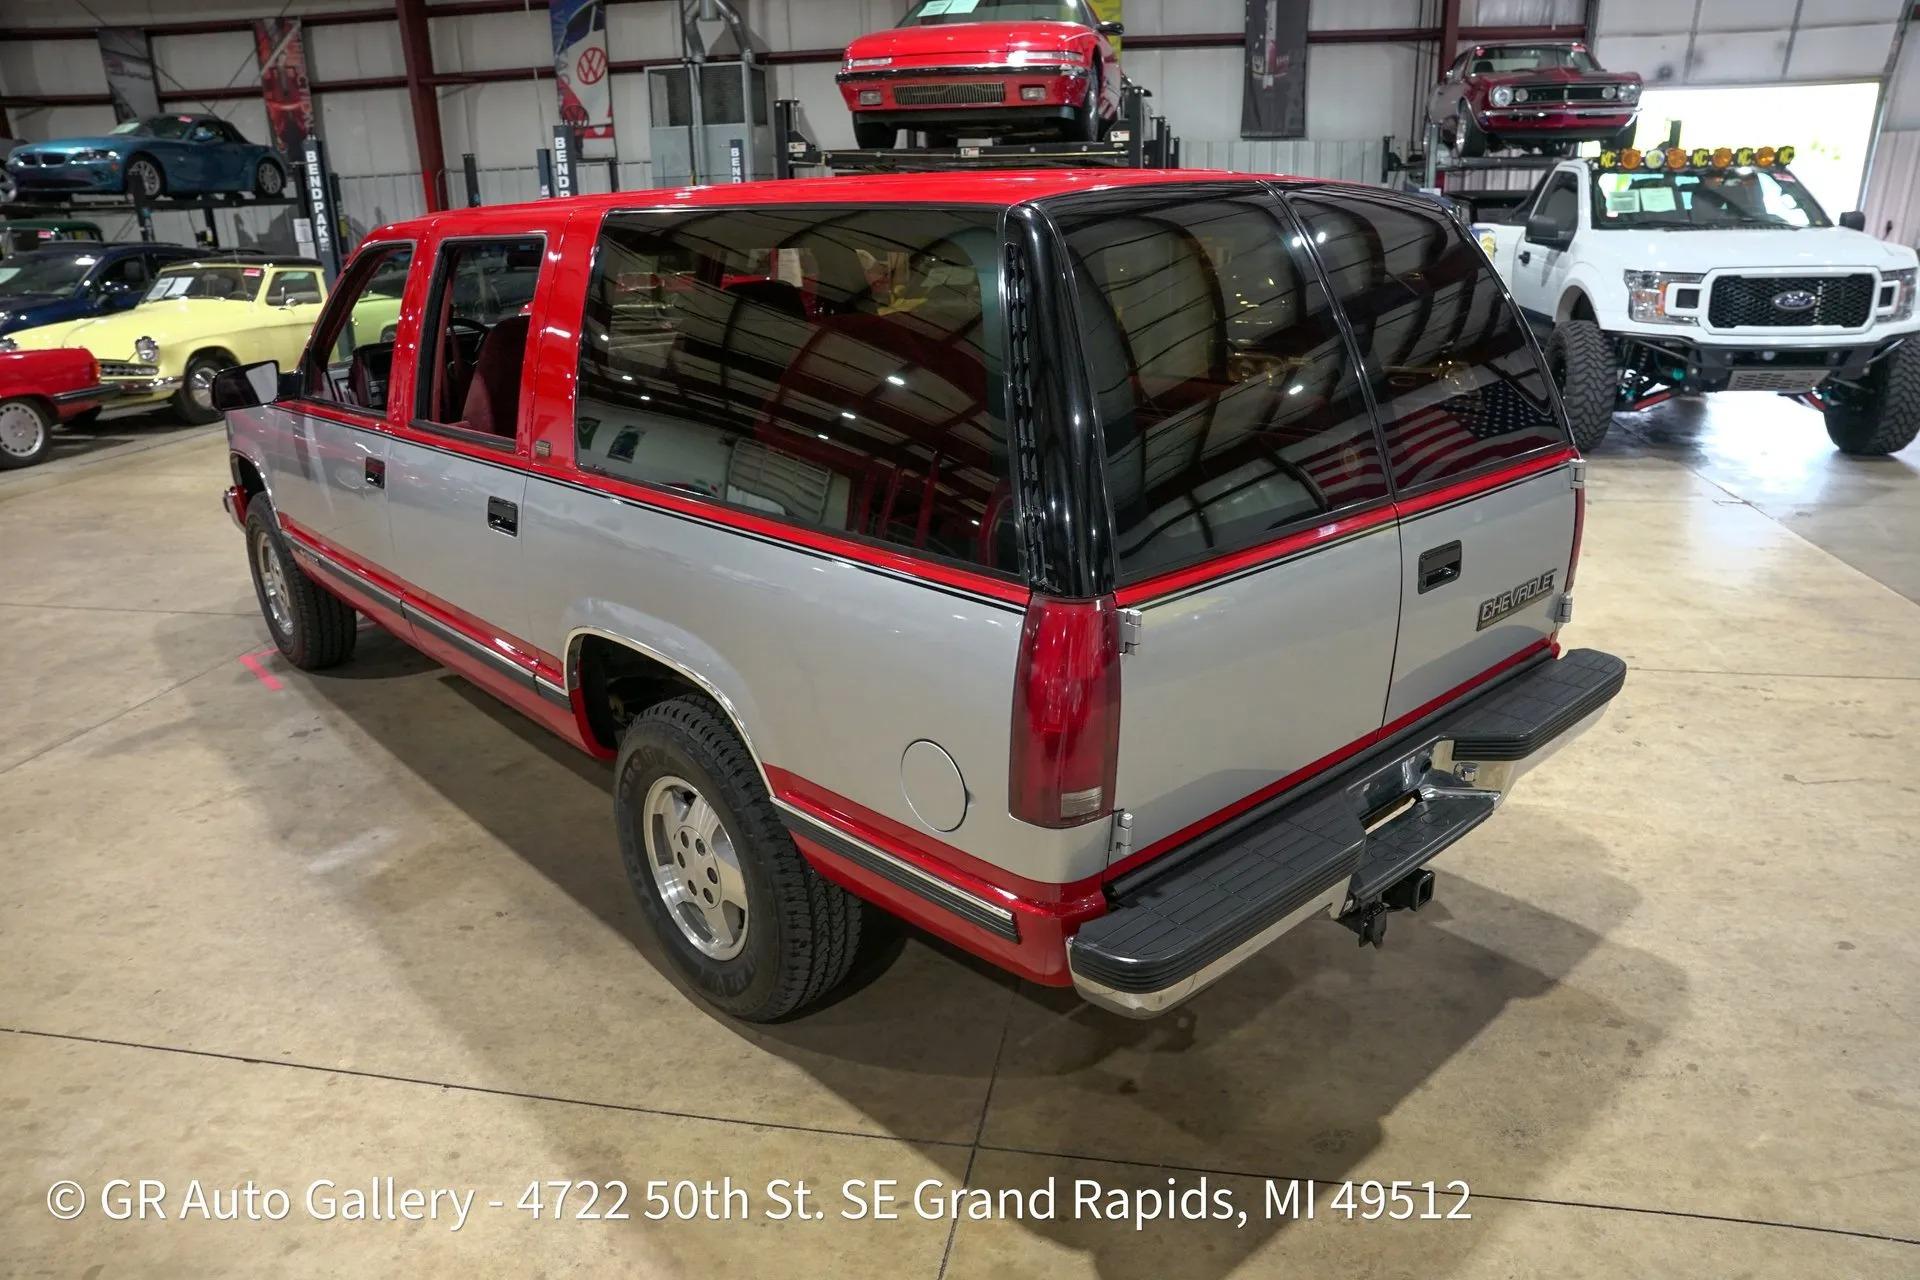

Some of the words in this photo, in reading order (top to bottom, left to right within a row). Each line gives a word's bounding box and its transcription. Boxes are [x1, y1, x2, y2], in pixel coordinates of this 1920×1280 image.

[1600, 150, 1617, 168] KC
[305, 150, 329, 238] BENDPAK
[1480, 573, 1556, 621] CHEVROLET
